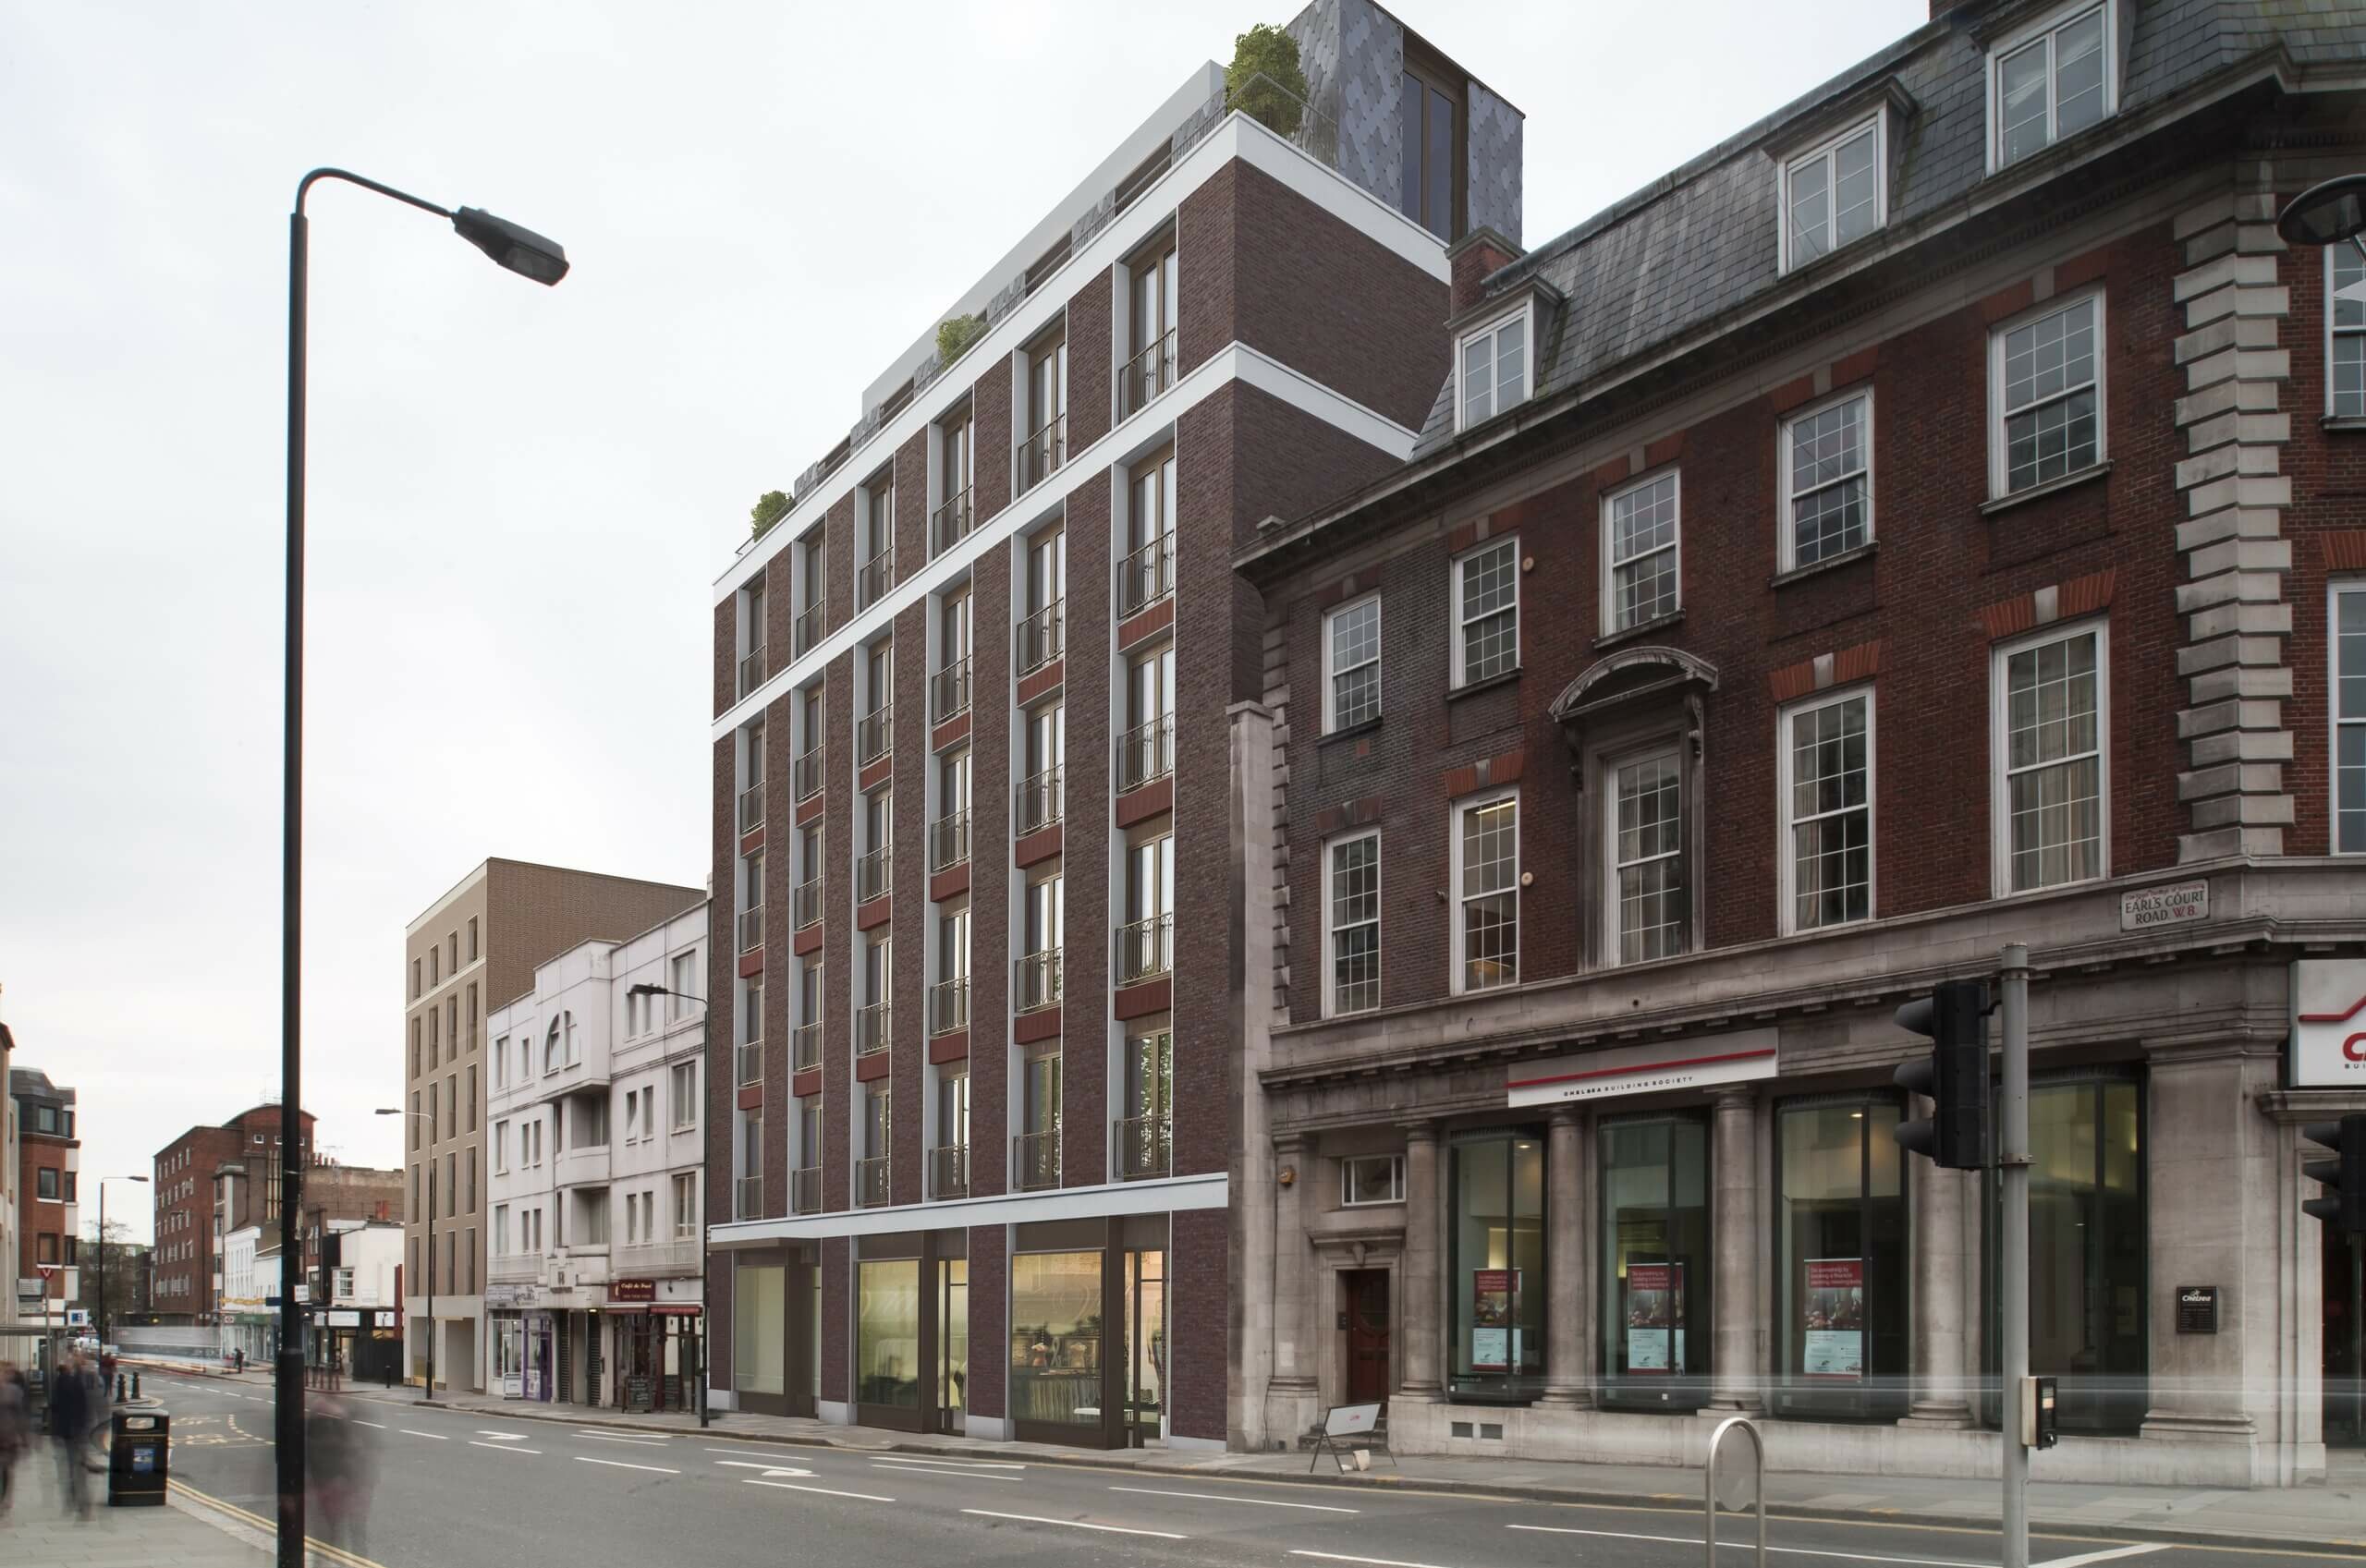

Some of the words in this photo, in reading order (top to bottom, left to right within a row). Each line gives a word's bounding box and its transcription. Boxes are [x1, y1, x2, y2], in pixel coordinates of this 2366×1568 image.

[2126, 896, 2161, 914] EARL'S
[2165, 891, 2204, 906] COURT
[1564, 1087, 1602, 1097] CHELSEA
[1604, 1081, 1649, 1091] BUILDING
[1653, 1076, 1693, 1086] SOCIETY
